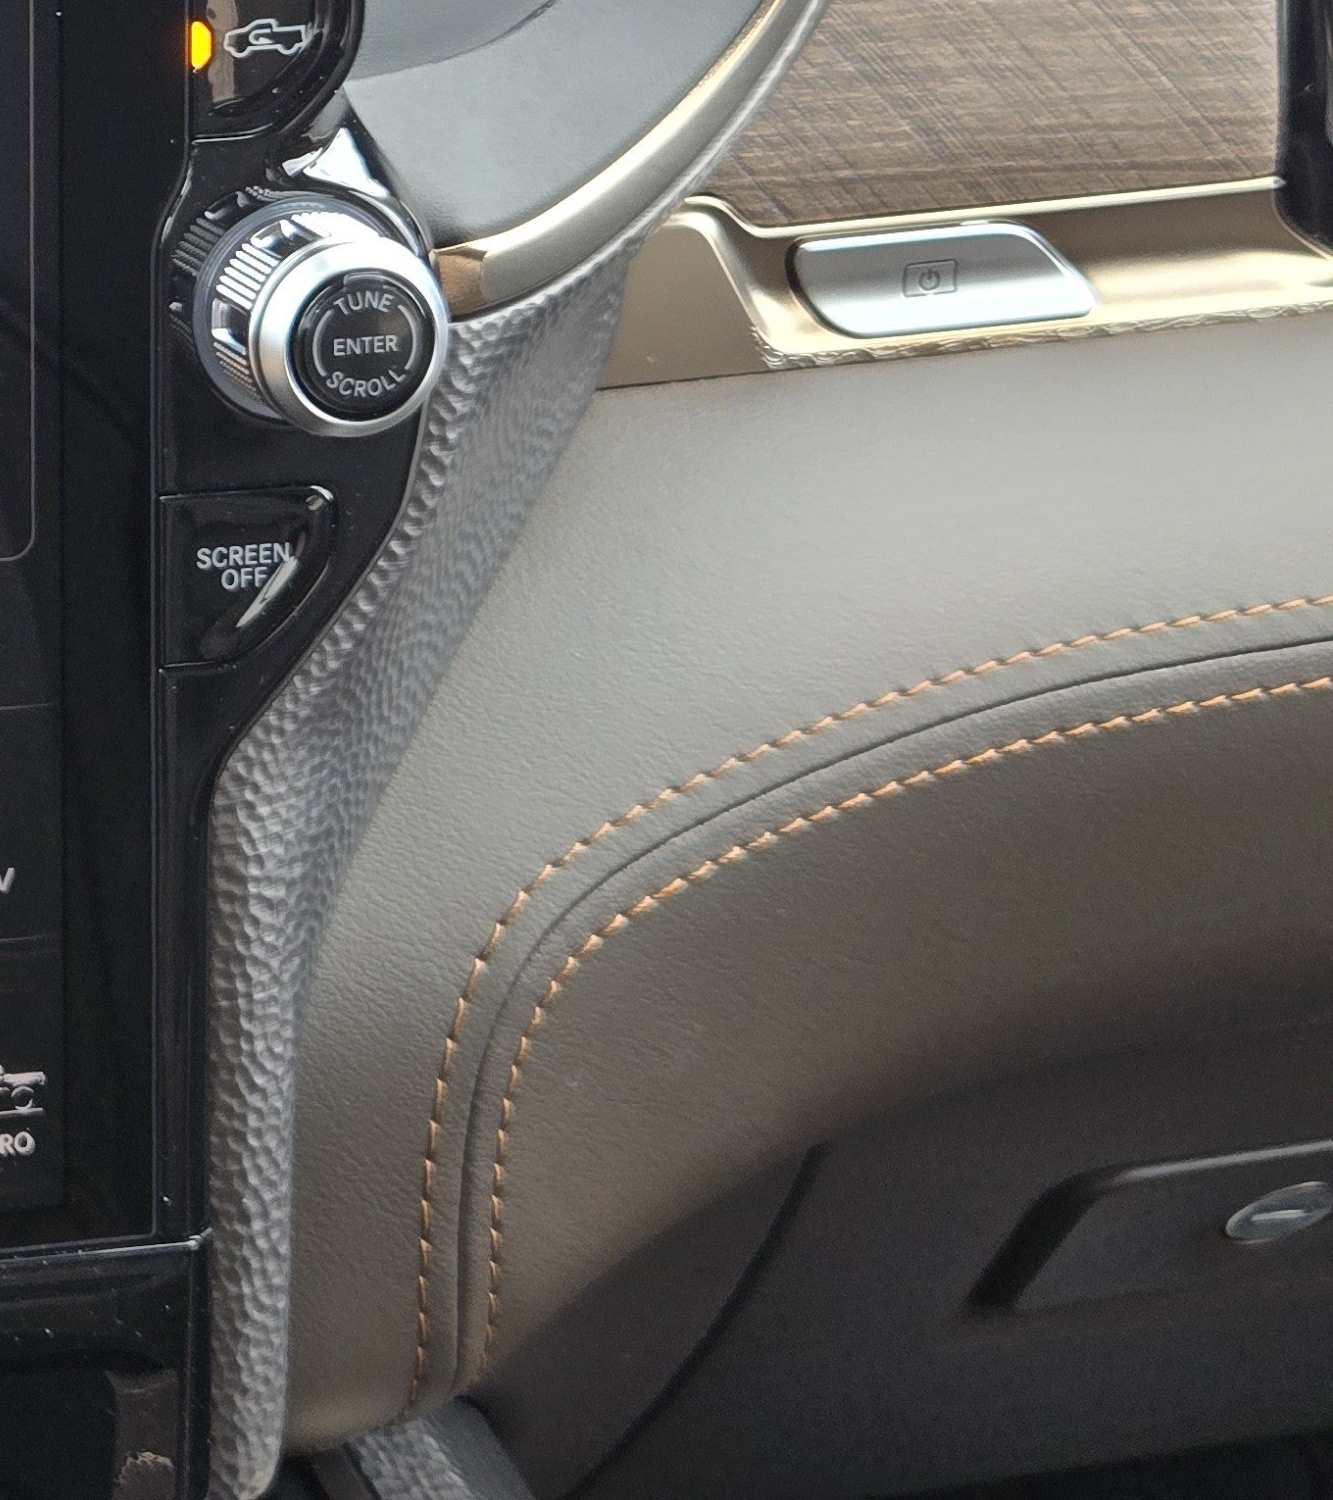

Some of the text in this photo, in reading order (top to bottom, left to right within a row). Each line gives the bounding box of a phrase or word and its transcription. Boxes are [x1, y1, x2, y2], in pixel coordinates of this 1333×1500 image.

[332, 291, 394, 317] TUNE
[333, 334, 399, 357] ENTER
[326, 366, 407, 397] SCROLL
[196, 542, 291, 570] SCREEN
[221, 565, 269, 590] OFF
